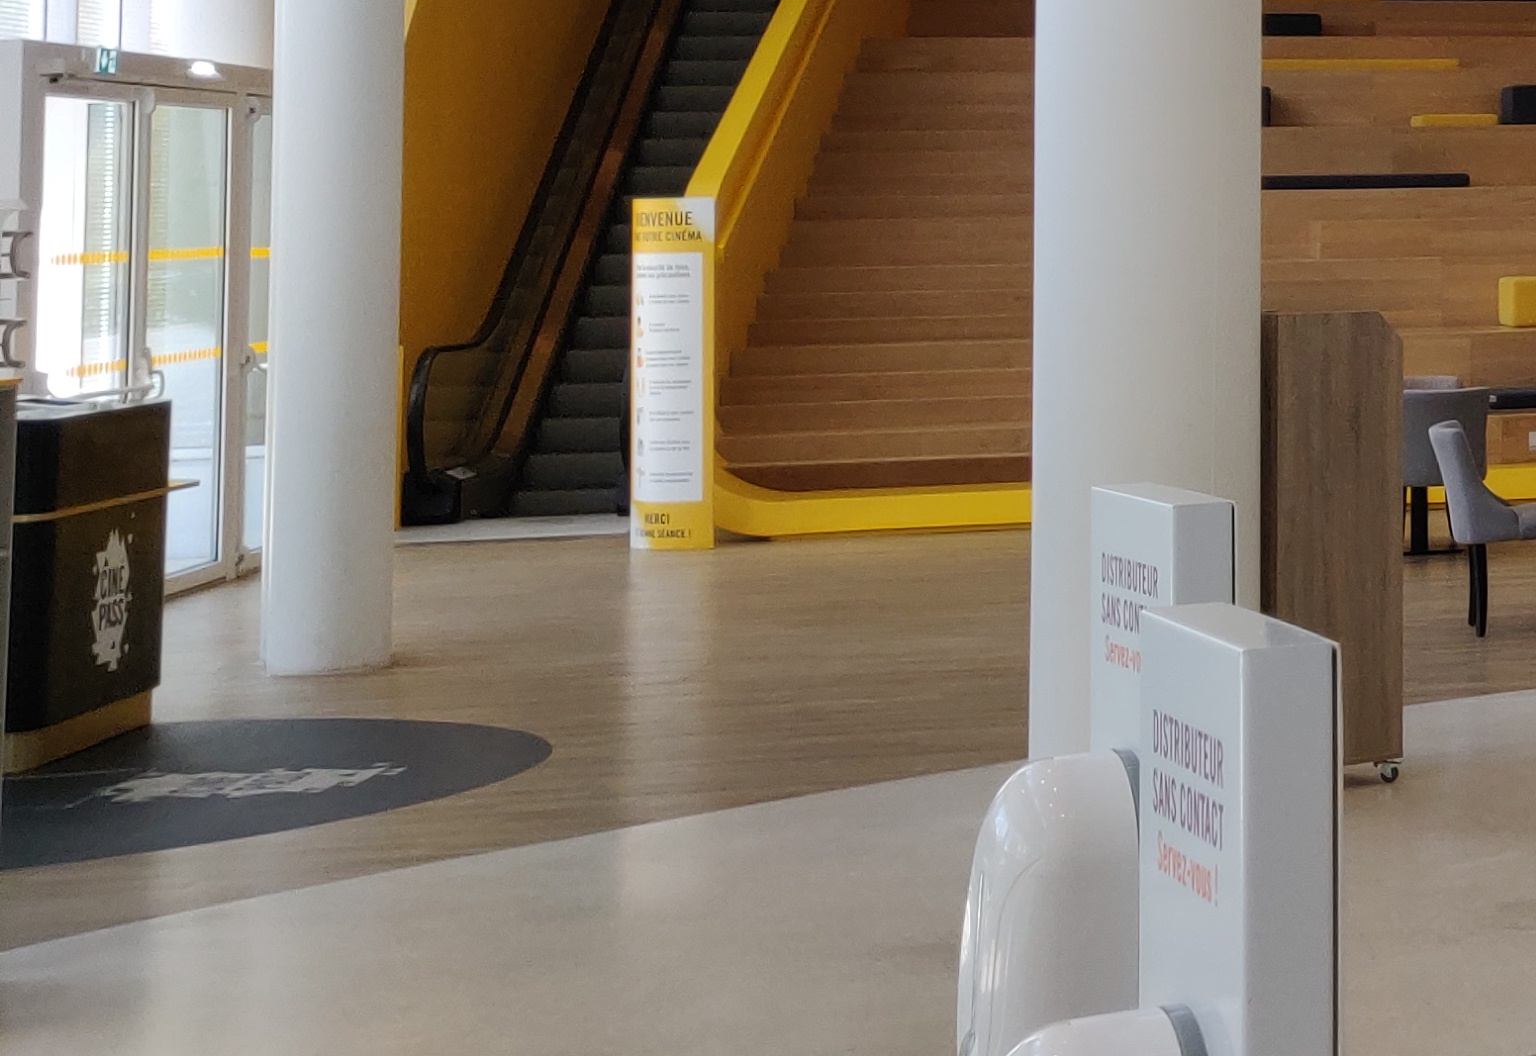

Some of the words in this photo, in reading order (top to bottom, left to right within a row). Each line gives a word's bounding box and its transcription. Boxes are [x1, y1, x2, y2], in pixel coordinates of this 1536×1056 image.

[1101, 551, 1158, 600] DISTRIBUTEUR
[1101, 591, 1121, 628] SANS
[1153, 709, 1225, 789] DISTRIBUTEUR
[1152, 767, 1177, 824] SANS
[1180, 781, 1225, 852] CONTACT
[1157, 829, 1213, 903] Servez-vous
